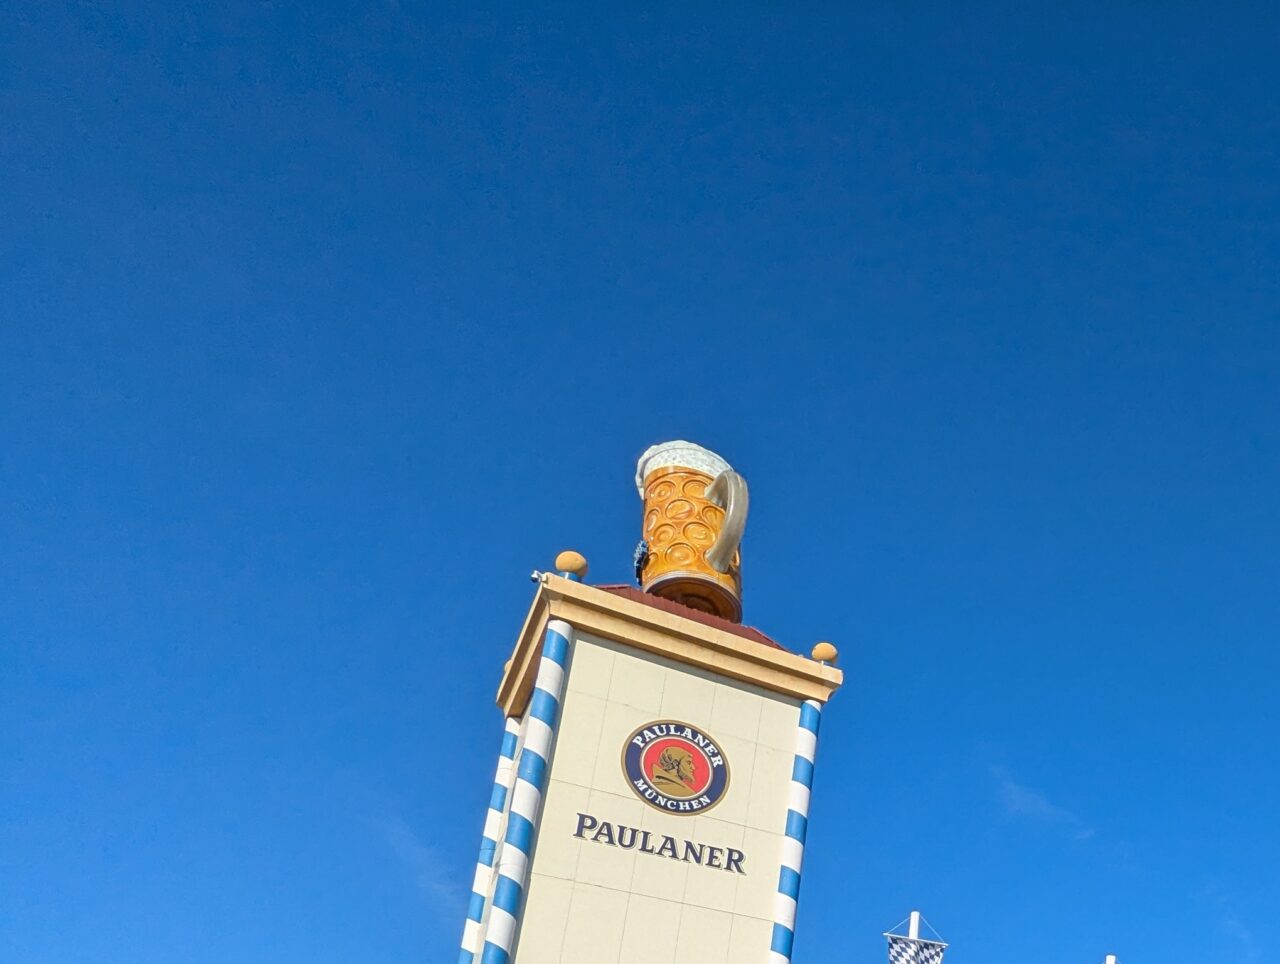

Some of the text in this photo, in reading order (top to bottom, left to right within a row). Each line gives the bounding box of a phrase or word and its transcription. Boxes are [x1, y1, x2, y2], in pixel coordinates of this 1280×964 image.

[632, 724, 724, 768] PAULANER
[634, 778, 711, 810] MÜNCHEN
[573, 812, 747, 876] PAULANER
